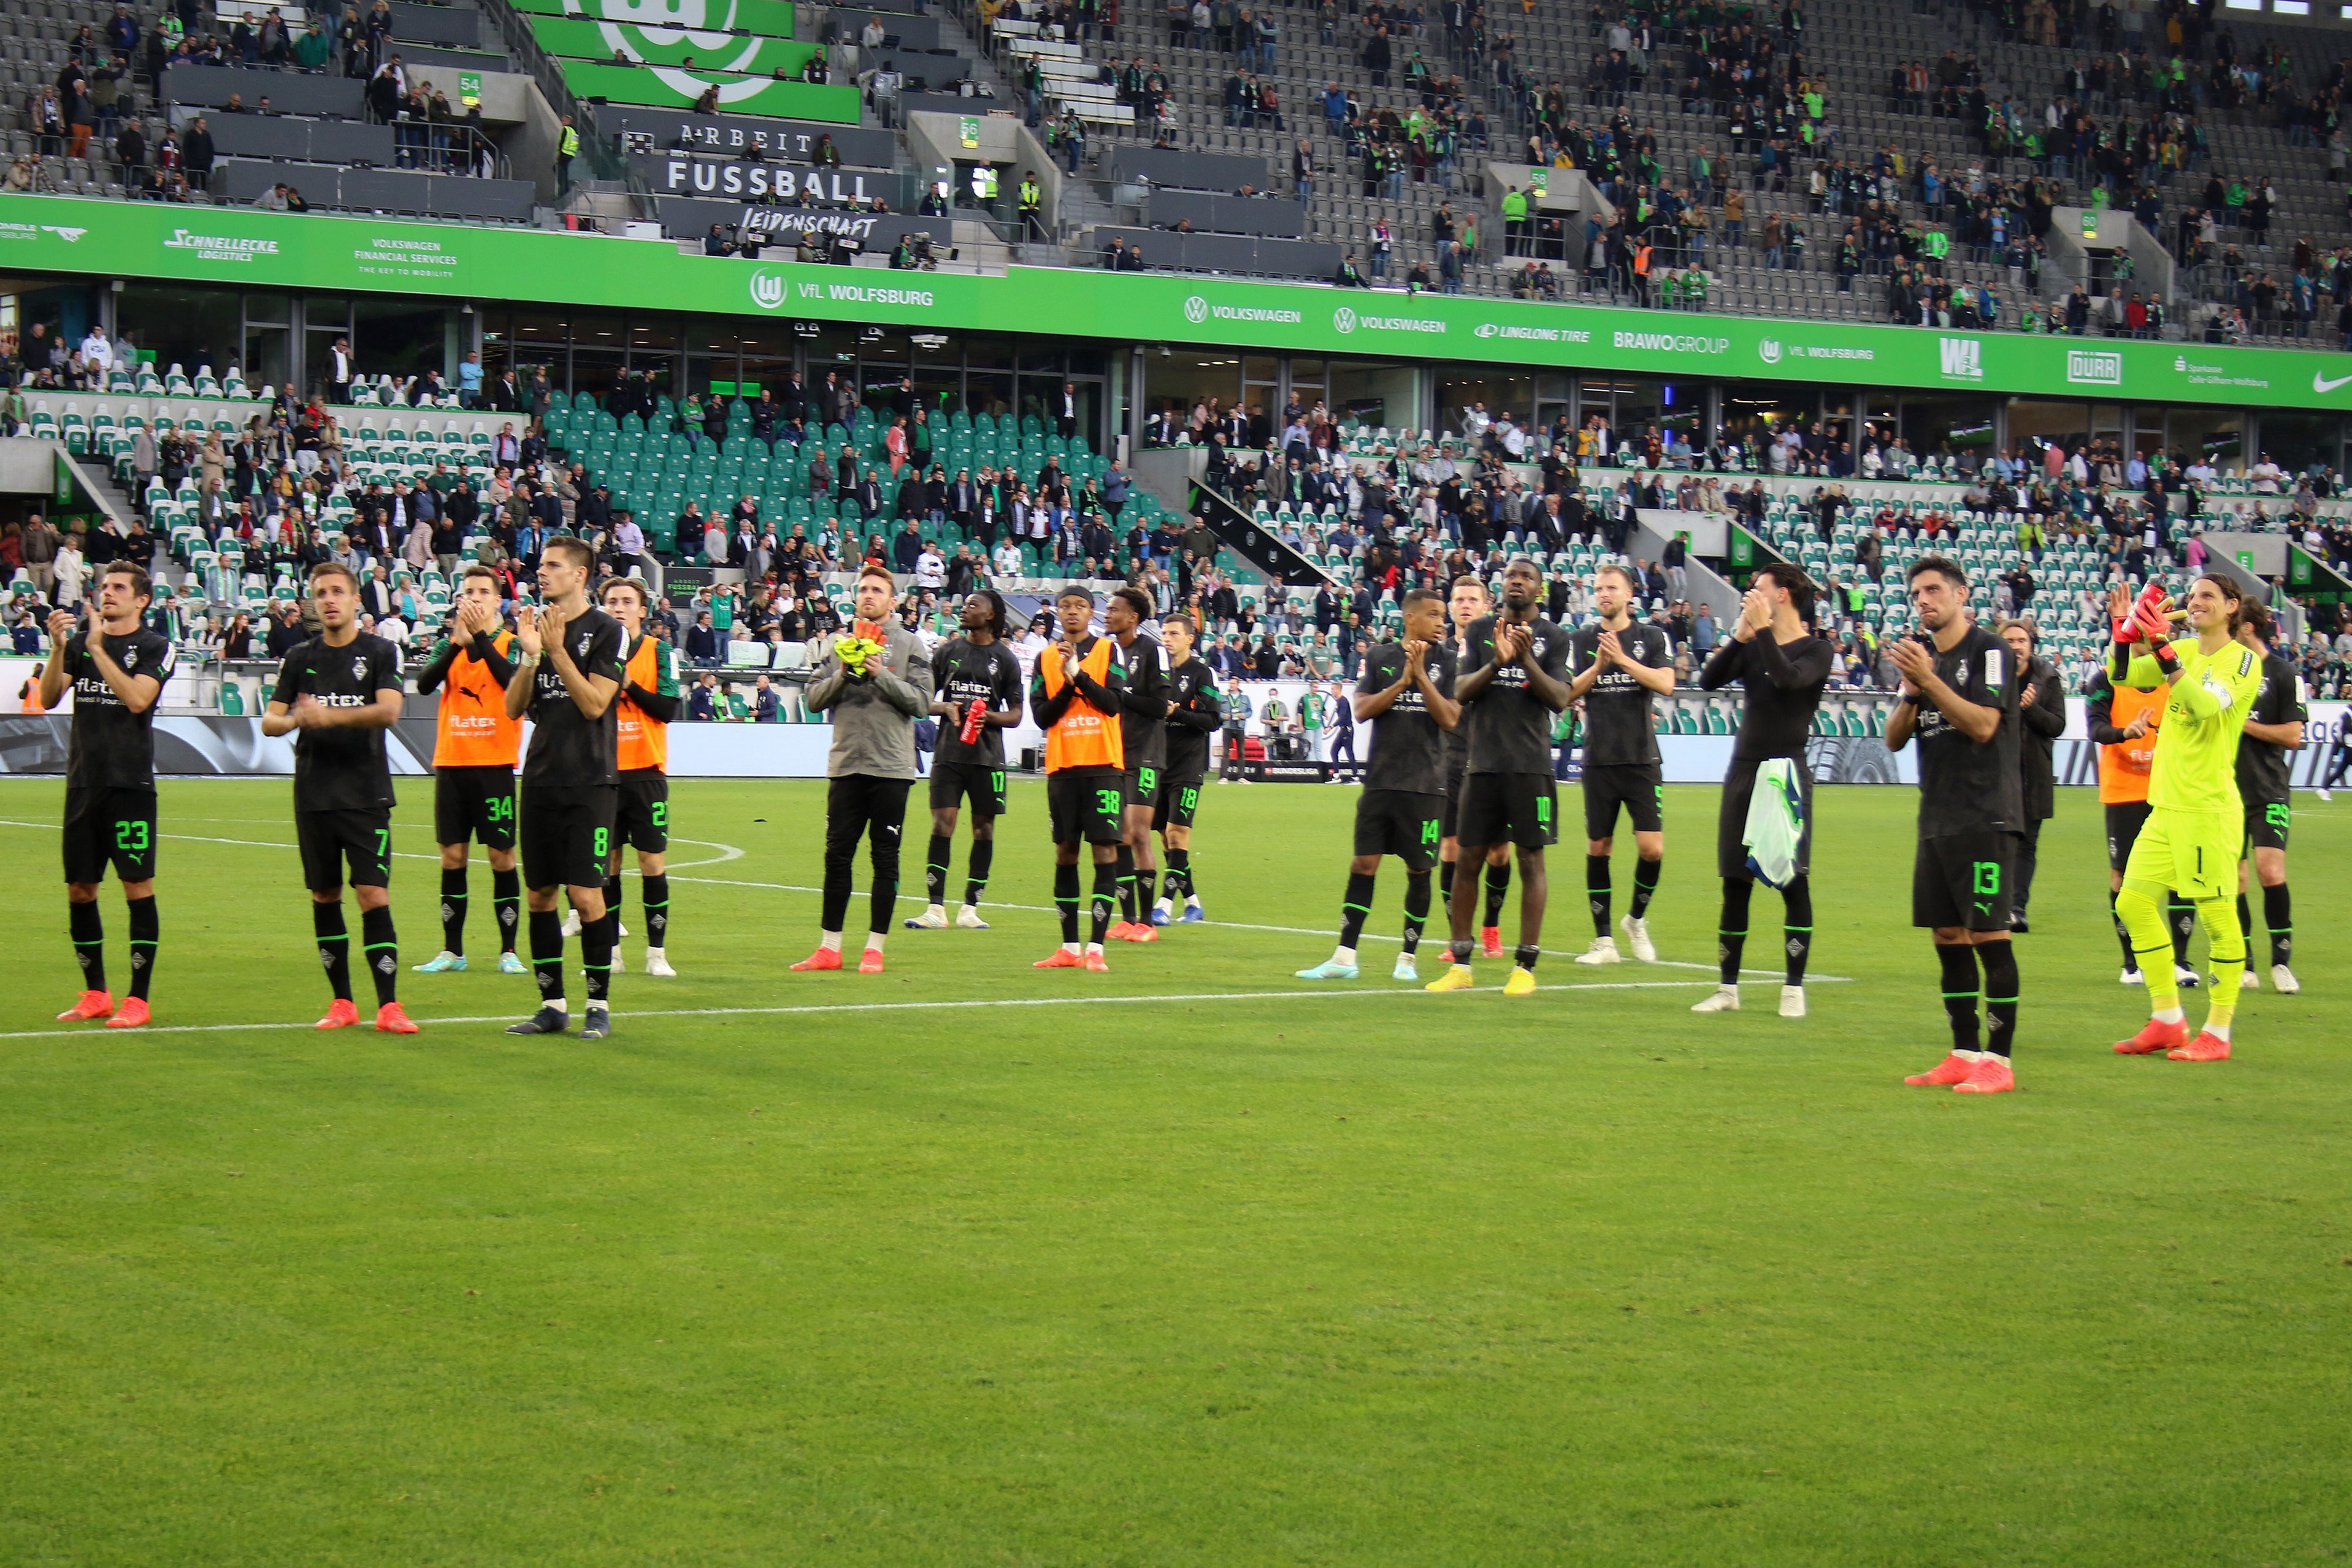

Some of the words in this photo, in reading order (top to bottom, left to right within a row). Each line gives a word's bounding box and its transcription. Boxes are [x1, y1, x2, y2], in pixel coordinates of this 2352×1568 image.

[460, 78, 480, 91] 54
[681, 125, 811, 153] ARBEIT
[960, 122, 978, 135] 56
[667, 161, 873, 203] FUSSBALL
[1531, 173, 1547, 185] 58
[163, 229, 279, 253] SCHNELLECKE
[372, 238, 441, 252] VOLKSWAGEN
[197, 250, 253, 262] LOGISTICS
[354, 245, 409, 262] FINANCIAL
[410, 248, 457, 265] SERVICES
[412, 269, 453, 278] MOBILITY
[798, 282, 824, 299] VfL
[828, 285, 934, 306] WOLFSBURG
[1211, 305, 1301, 323] VOLKSWAGEN
[1359, 316, 1446, 333] VOLKSWAGEN
[1499, 326, 1559, 341] LINGLONG
[1561, 330, 1591, 343] TIRE
[1613, 331, 1729, 354] BRAWOGROUP
[1788, 345, 1806, 357] VfL
[1807, 347, 1875, 360] WOLFSBURG
[2239, 651, 2251, 676] sonepar
[991, 771, 1005, 793] 17
[1138, 767, 1156, 789] 19
[1272, 767, 1319, 775] BUNDESLIGA
[485, 795, 513, 821] 34
[1095, 789, 1121, 814] 38
[1180, 787, 1198, 810] 18
[1536, 796, 1551, 823] 10
[652, 801, 670, 827] 2
[2265, 803, 2291, 828] 29
[115, 820, 149, 850] 23
[375, 828, 389, 857] 7
[594, 827, 609, 857] 8
[1421, 819, 1440, 845] 14
[2196, 845, 2203, 874] 1
[1973, 861, 2000, 895] 13
